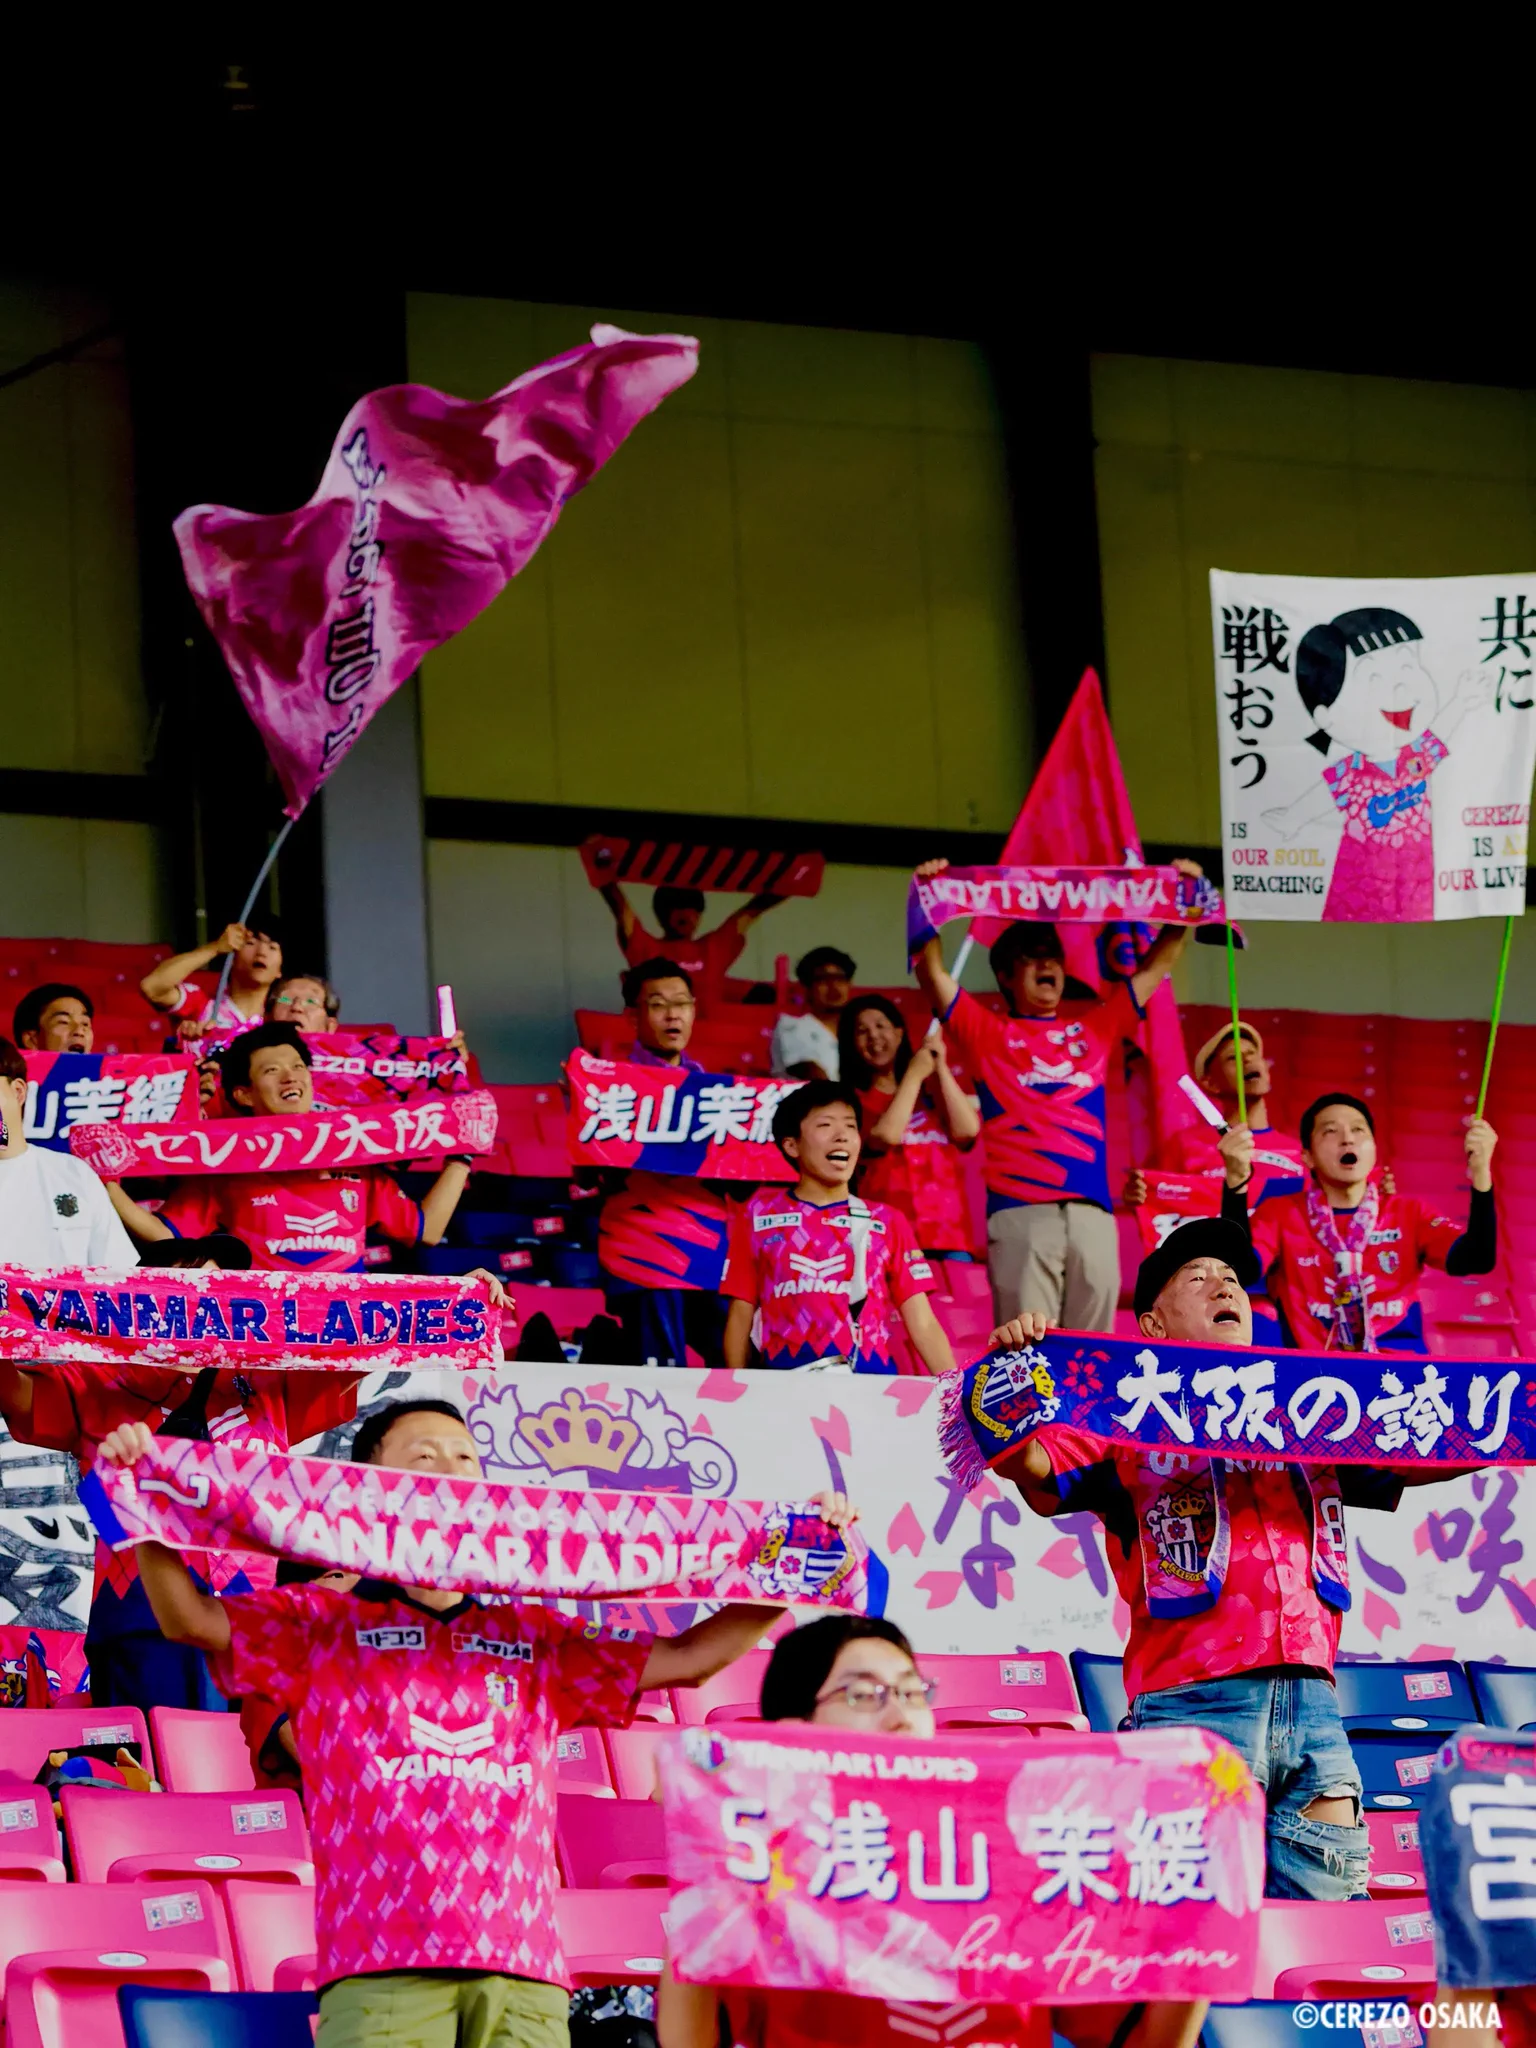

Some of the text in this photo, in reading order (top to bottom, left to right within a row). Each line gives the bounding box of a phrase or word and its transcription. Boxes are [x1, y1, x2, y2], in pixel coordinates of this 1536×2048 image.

[1479, 595, 1536, 713] 共に
[1219, 605, 1290, 790] 戦おう
[1231, 822, 1247, 839] IS
[1473, 836, 1493, 858] IS
[1232, 848, 1325, 867] OUR SOUL
[1017, 877, 1171, 910] YANMAR
[1232, 874, 1324, 895] REACHING
[1438, 868, 1478, 892] OUR
[372, 1059, 467, 1079] OSAKA
[134, 1101, 458, 1169] セレッソ大阪
[265, 1234, 357, 1255] YANMAR
[773, 1278, 850, 1298] YANMA
[15, 1287, 271, 1343] YANMAR
[281, 1298, 488, 1348] LADIES
[1307, 1300, 1403, 1319] YAAR
[1110, 1348, 1520, 1457] 大阪の誇り
[328, 1482, 665, 1537] CEREZO OSAKA
[258, 1500, 538, 1588] YANMAR
[373, 1753, 533, 1788] YANMAR
[720, 1798, 771, 1885] 5
